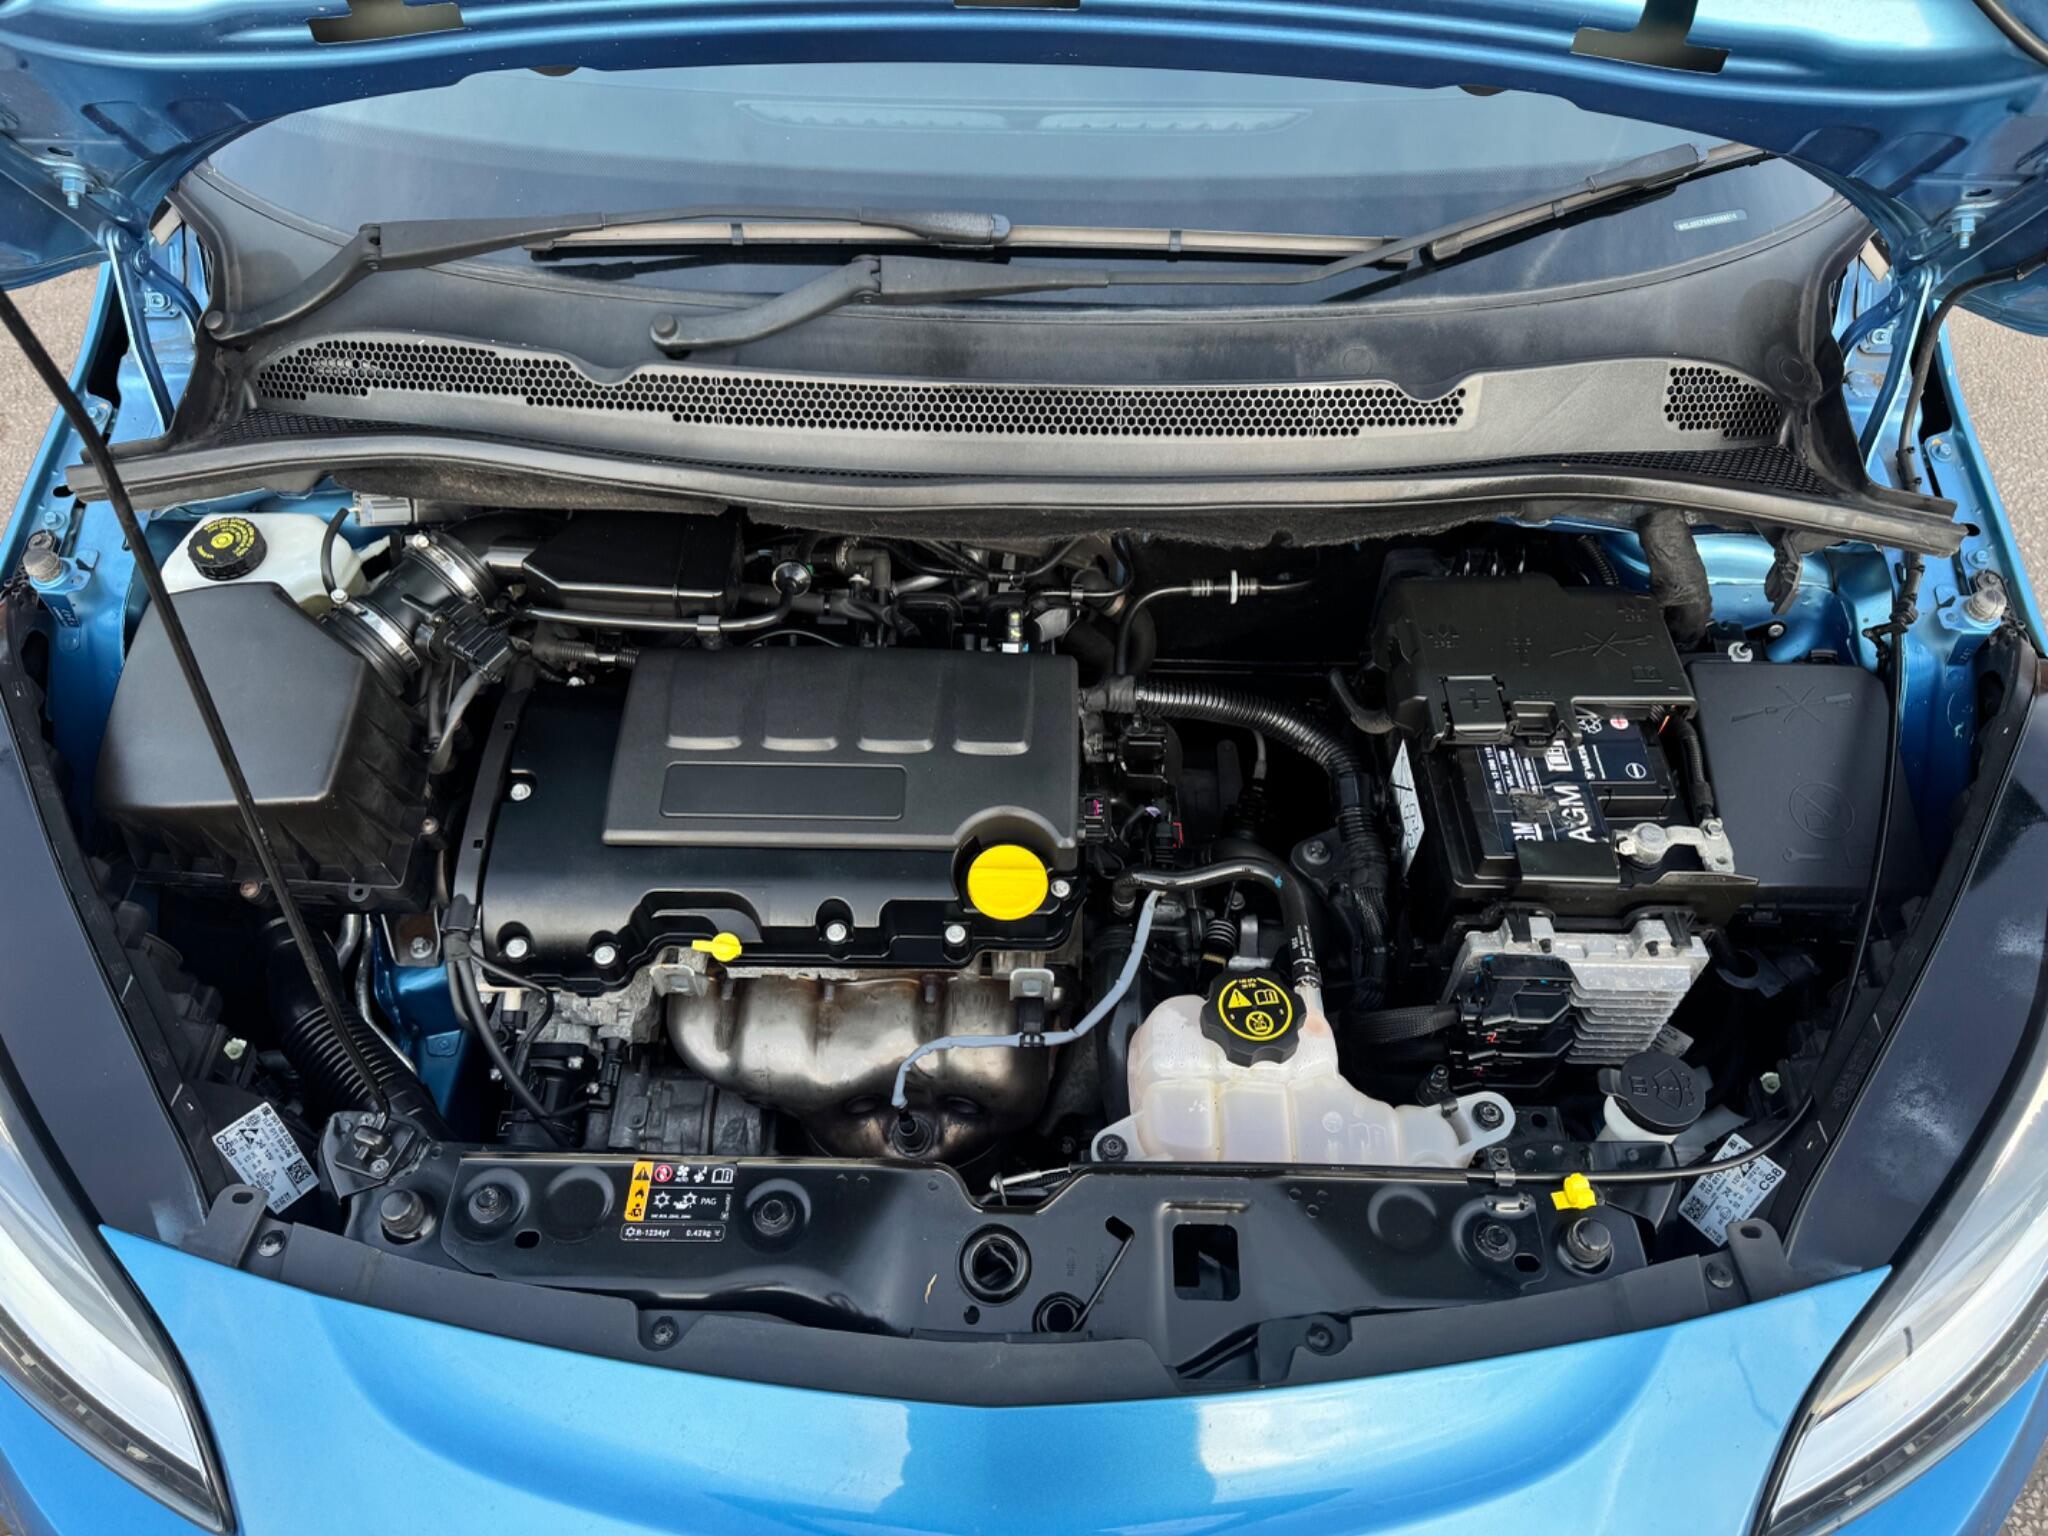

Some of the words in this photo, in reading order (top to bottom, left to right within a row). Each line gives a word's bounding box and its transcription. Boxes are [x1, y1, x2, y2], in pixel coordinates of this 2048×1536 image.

[1553, 785, 1596, 843] AGM
[216, 1135, 237, 1157] CS9
[700, 1197, 717, 1206] PAG
[635, 1228, 670, 1238] R-1234yf
